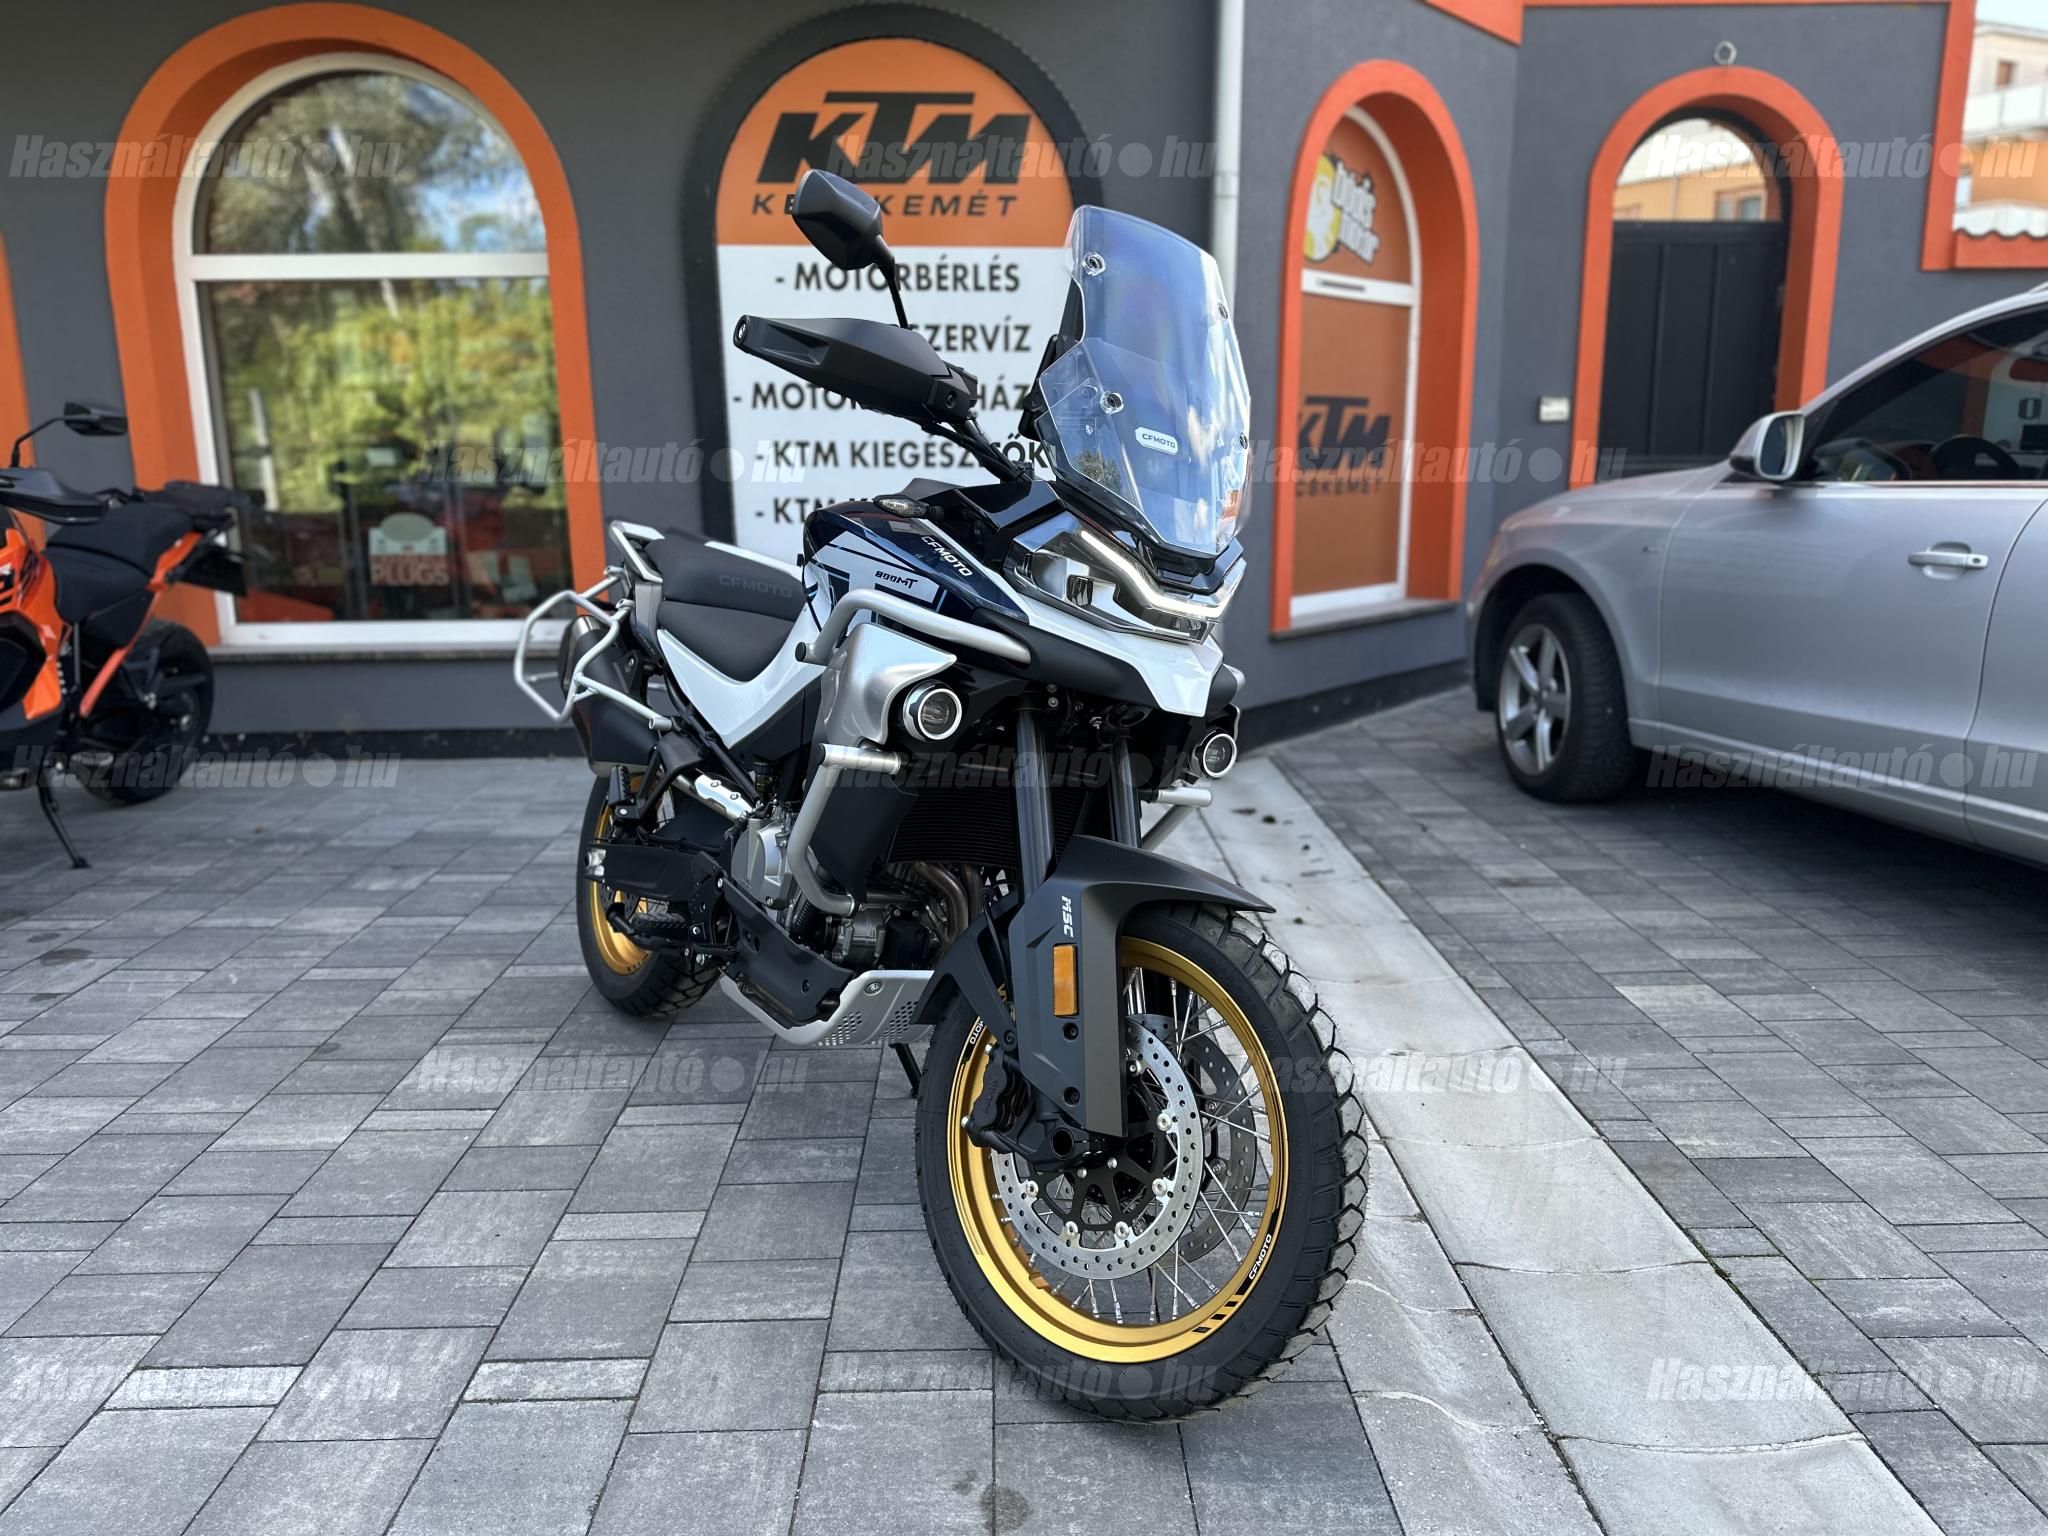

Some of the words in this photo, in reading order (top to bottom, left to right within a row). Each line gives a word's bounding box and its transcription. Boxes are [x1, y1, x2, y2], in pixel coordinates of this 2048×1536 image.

[757, 91, 1032, 184] KTM
[752, 189, 1018, 216] KEKEMÉT
[909, 314, 1031, 352] ZERVÍZ
[773, 441, 838, 468] KTM
[1142, 433, 1176, 449] CFMOTO
[920, 535, 973, 577] CFMOTO
[719, 575, 792, 598] CFMOTO
[874, 570, 918, 589] 800MT
[1061, 895, 1074, 938] MSC
[1248, 1233, 1272, 1280] CFMOTO
